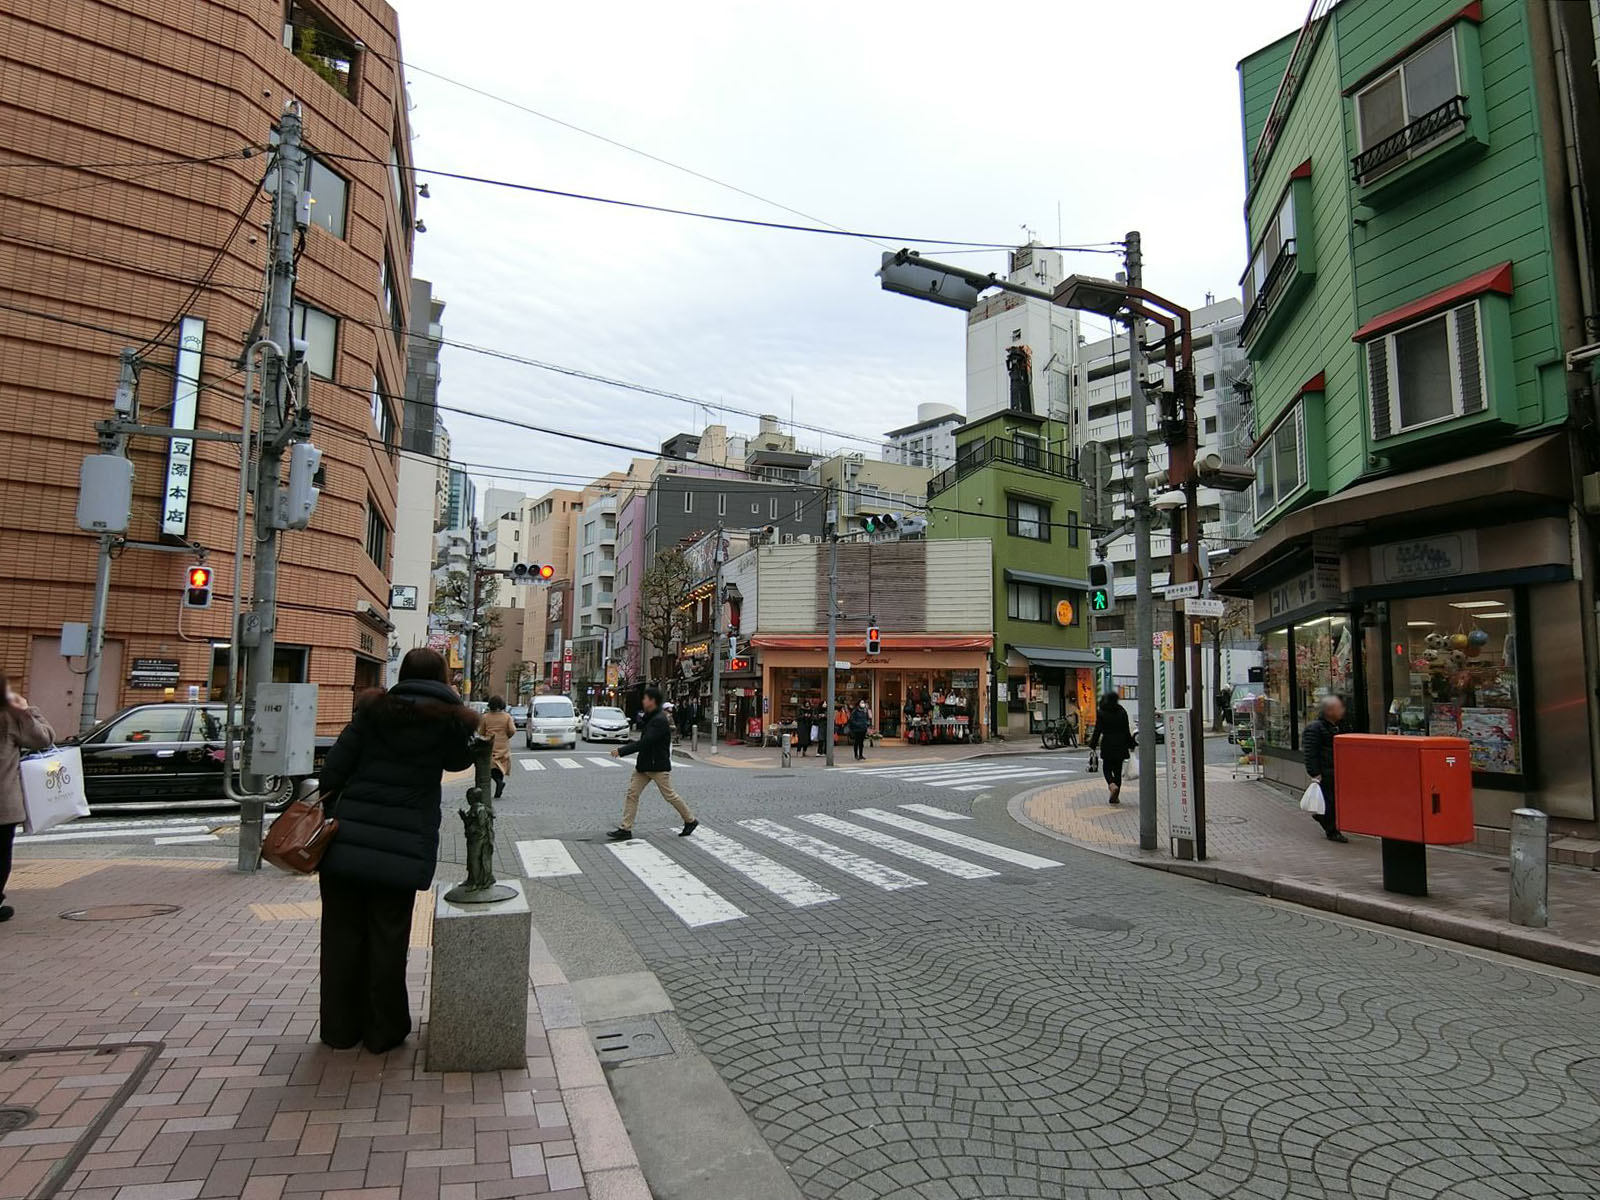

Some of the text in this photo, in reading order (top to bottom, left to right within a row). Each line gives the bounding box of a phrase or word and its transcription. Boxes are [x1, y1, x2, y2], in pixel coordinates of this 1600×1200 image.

[166, 441, 190, 523] 豆源本店
[394, 586, 414, 606] 豆源
